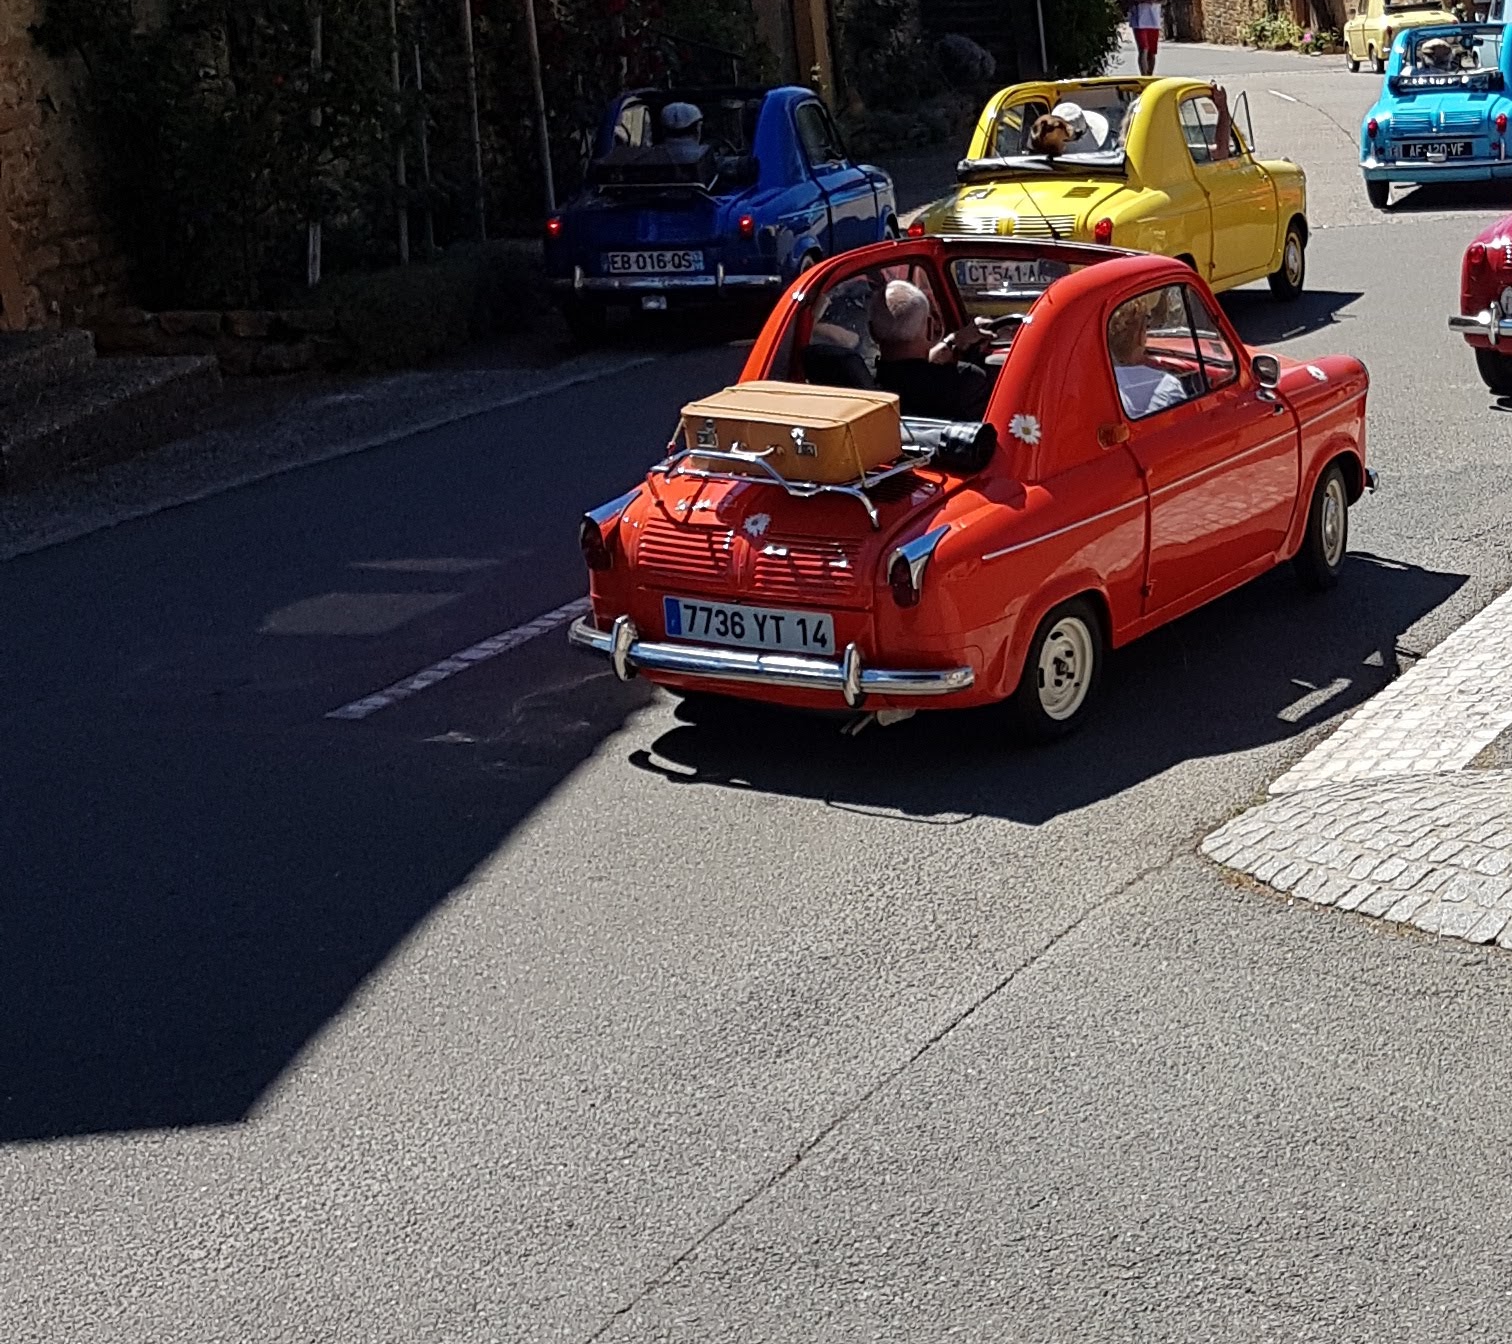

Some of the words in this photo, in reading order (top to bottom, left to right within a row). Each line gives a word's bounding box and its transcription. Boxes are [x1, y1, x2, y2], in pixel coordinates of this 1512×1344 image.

[683, 604, 746, 639] 7736
[753, 613, 785, 644] YT
[796, 618, 828, 648] 14
